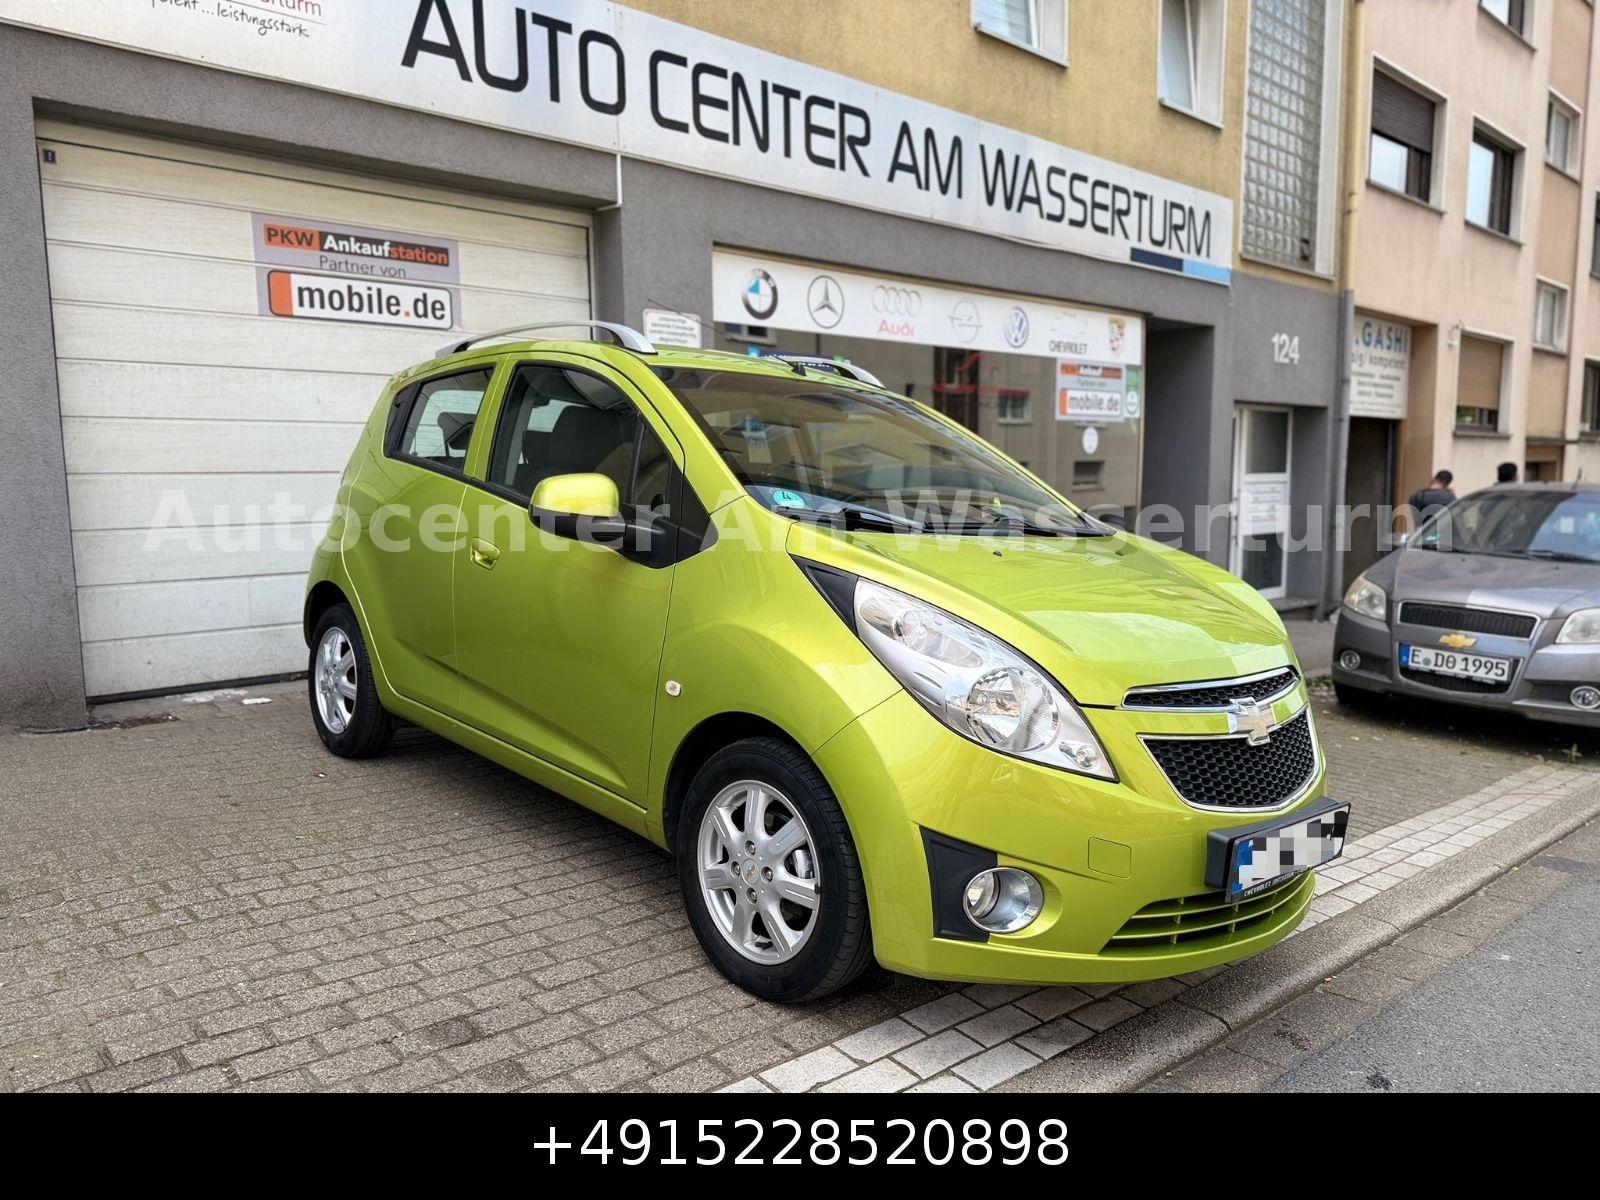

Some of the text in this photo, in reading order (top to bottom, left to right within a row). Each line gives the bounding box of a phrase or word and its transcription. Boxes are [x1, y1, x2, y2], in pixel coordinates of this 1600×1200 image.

[400, 0, 1212, 259] AUTO CENTER AM WASSERTURM
[266, 227, 314, 246] PKW
[319, 255, 406, 278] Partner von
[297, 285, 446, 321] mobile.de
[878, 319, 915, 336] Audi
[1049, 340, 1088, 355] CHEVROLET
[1271, 333, 1300, 365] 124
[1069, 394, 1119, 412] mobile.de
[1411, 649, 1422, 664] E
[1460, 657, 1506, 677] 1995
